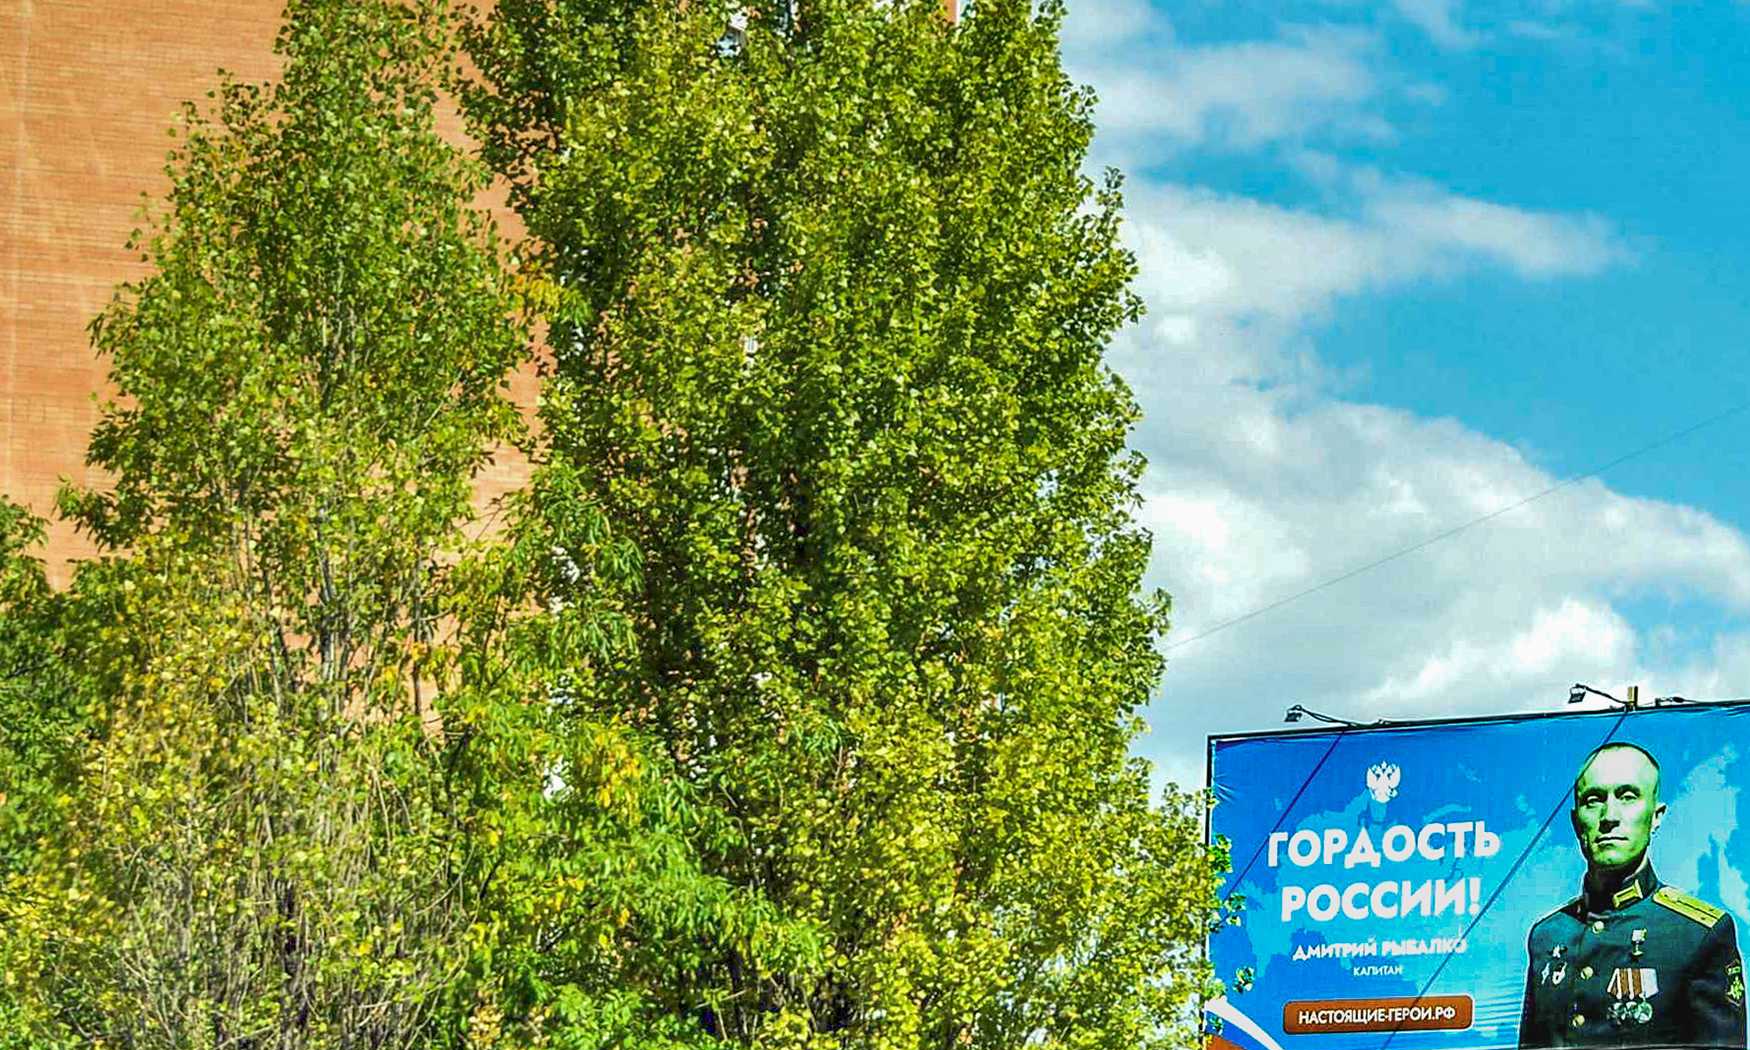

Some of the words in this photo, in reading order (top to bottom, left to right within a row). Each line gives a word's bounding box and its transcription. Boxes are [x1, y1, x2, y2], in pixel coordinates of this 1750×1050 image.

[1267, 821, 1501, 869] ГОРДОСТЬ
[1280, 877, 1482, 922] РОССИИ!
[1292, 936, 1378, 961] ДМИТРИЙ
[1381, 936, 1468, 956] РЫБАЛКО
[1353, 965, 1403, 976] КАПИТАН
[1299, 1006, 1456, 1025] НАСТОЯЩИЕ-ГЕРОИ.РФ
